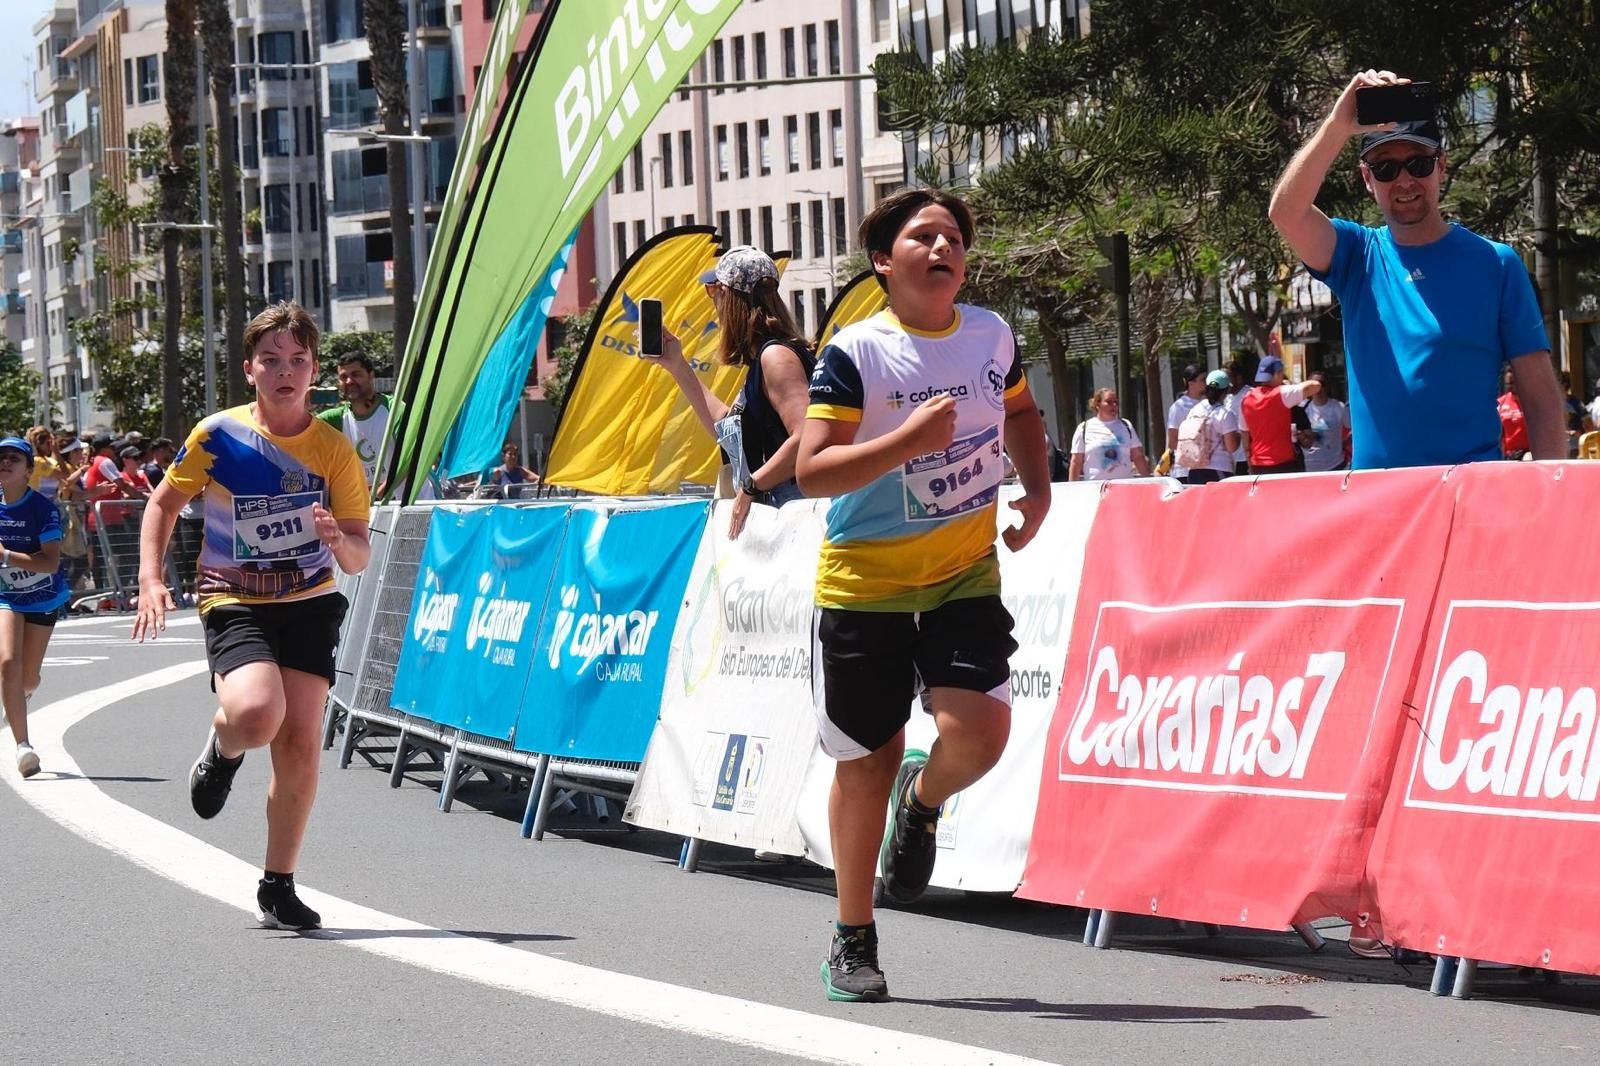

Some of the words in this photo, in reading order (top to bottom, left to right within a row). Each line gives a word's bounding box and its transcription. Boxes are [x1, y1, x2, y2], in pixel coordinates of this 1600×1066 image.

[601, 335, 645, 360] DIS
[928, 457, 983, 498] 9164
[237, 499, 268, 513] HPS
[256, 516, 303, 541] 9211
[719, 646, 737, 676] Isla
[737, 646, 776, 684] Europea
[776, 647, 796, 679] del
[793, 647, 812, 688] Dep
[1009, 664, 1051, 704] porte
[1068, 645, 1346, 780] Canarias7
